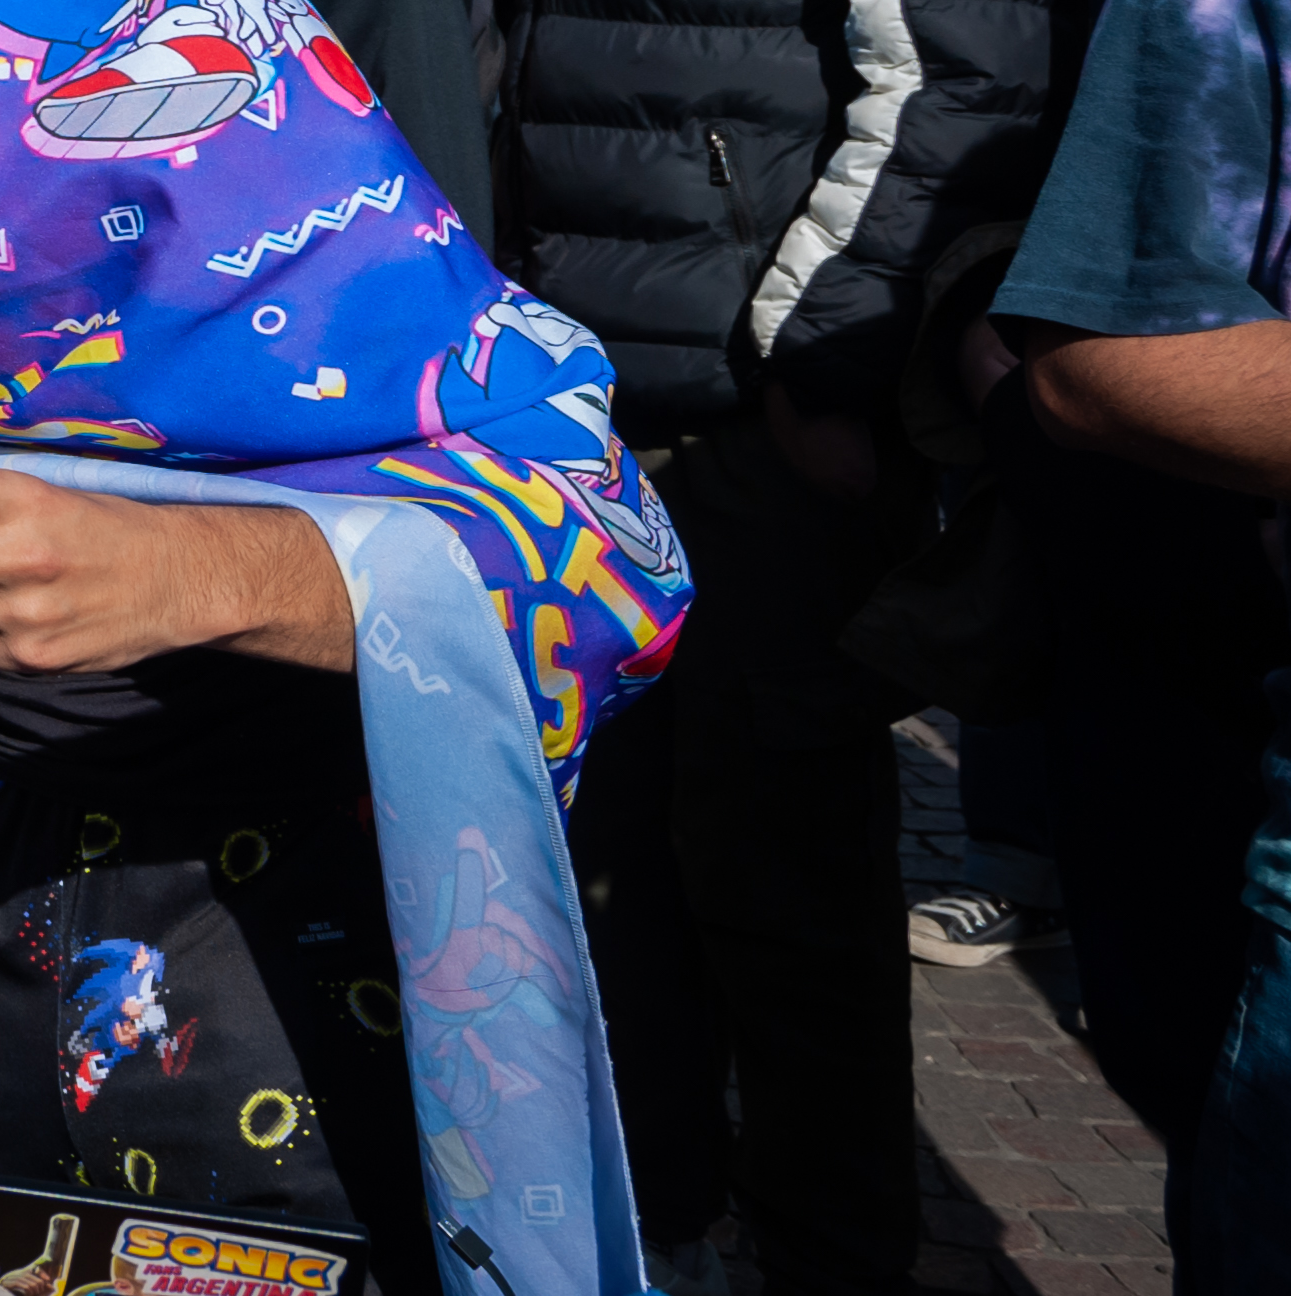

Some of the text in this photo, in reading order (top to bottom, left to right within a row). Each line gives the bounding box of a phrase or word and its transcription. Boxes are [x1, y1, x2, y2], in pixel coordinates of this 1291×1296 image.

[120, 1224, 337, 1292] SONIC
[143, 1263, 183, 1277] FANS
[150, 1275, 318, 1296] ARGENTIN
